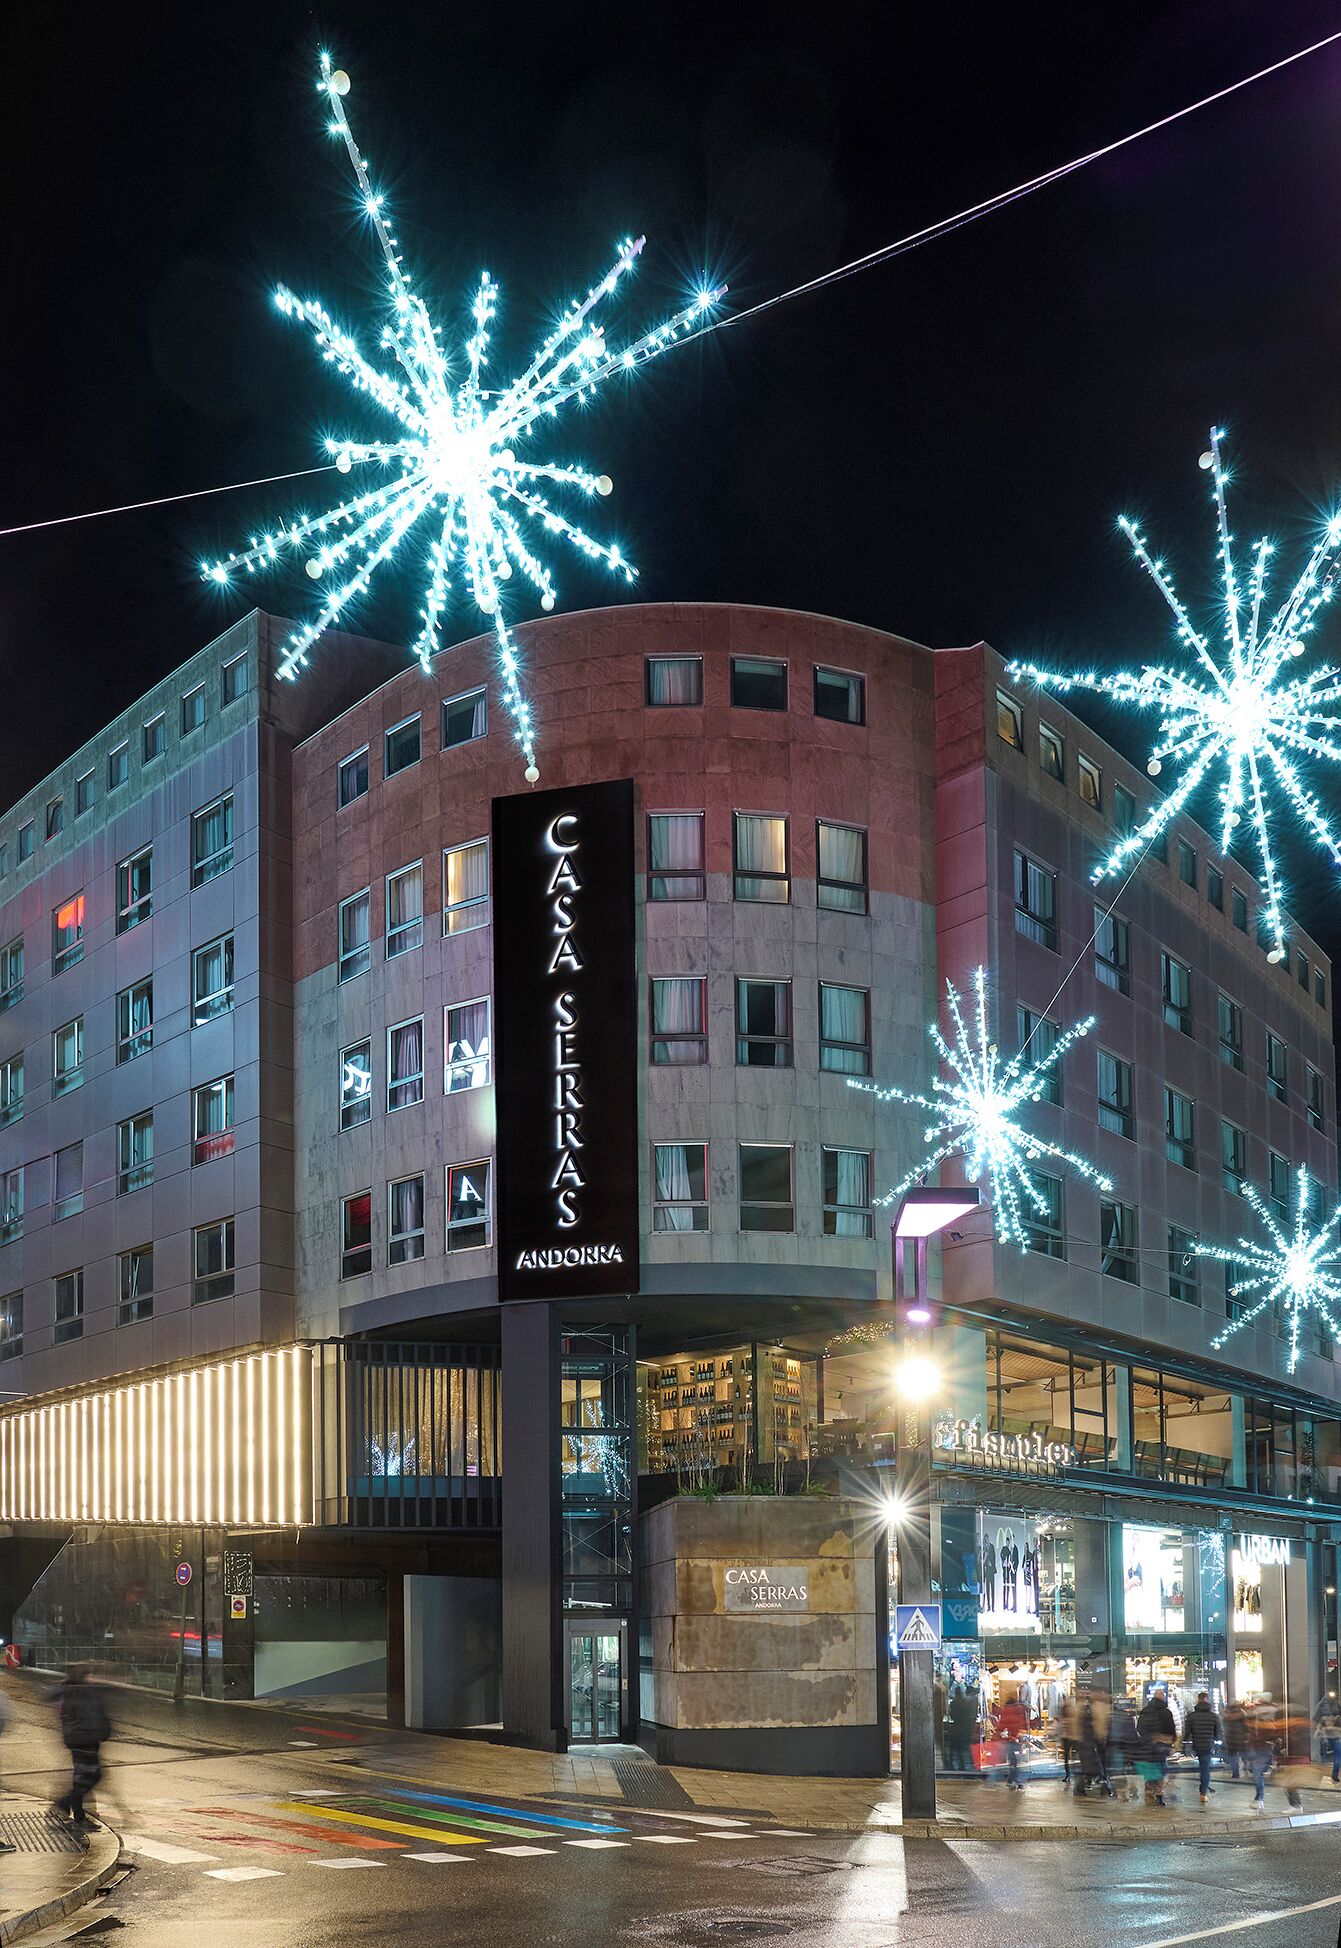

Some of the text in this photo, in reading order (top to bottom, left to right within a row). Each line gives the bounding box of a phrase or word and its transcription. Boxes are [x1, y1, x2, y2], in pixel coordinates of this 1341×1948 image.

[546, 811, 588, 1228] CASA SERRAS
[516, 1243, 624, 1269] ANDORRA
[1240, 1533, 1290, 1565] URBAN
[725, 1570, 770, 1584] CASA
[751, 1586, 807, 1600] SERRAS
